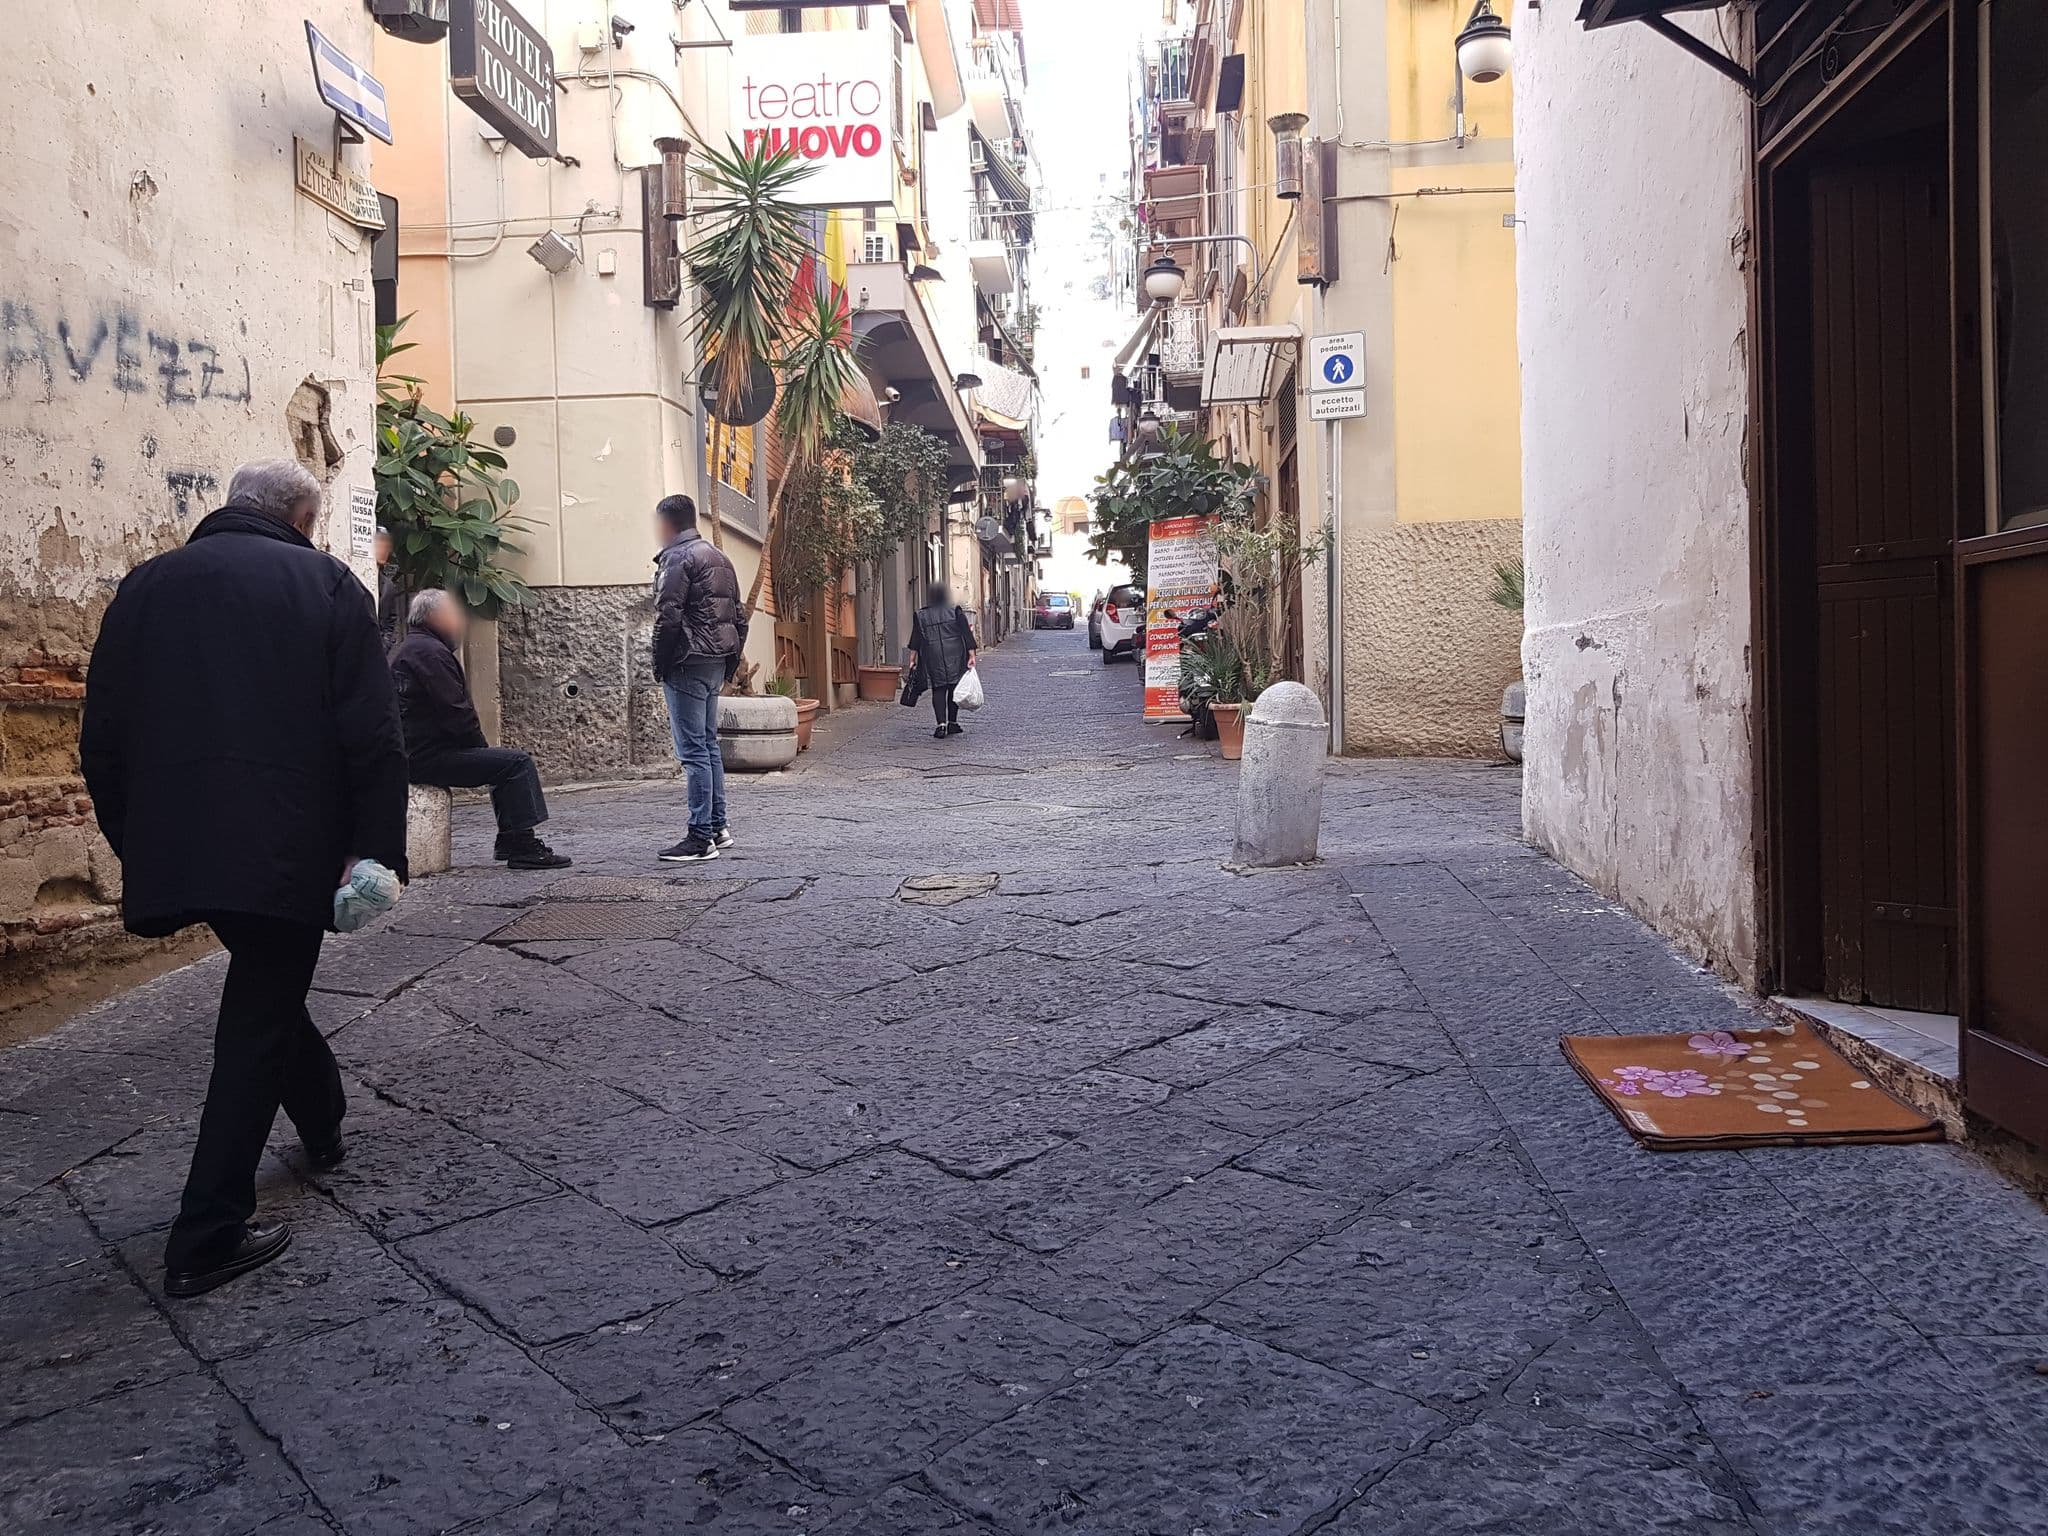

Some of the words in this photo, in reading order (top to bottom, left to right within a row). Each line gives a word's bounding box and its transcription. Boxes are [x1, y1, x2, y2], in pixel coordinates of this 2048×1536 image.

[487, 0, 545, 89] HOTEL
[481, 45, 550, 139] TOLEDO
[742, 72, 881, 120] teatro
[743, 123, 882, 161] nuovo
[300, 148, 350, 212] LETTERISTA
[1320, 343, 1354, 353] pedonale
[1328, 337, 1345, 345] area
[1315, 404, 1360, 415] autorizzati
[1321, 396, 1354, 405] eccetto
[1192, 585, 1212, 595] MUSICA
